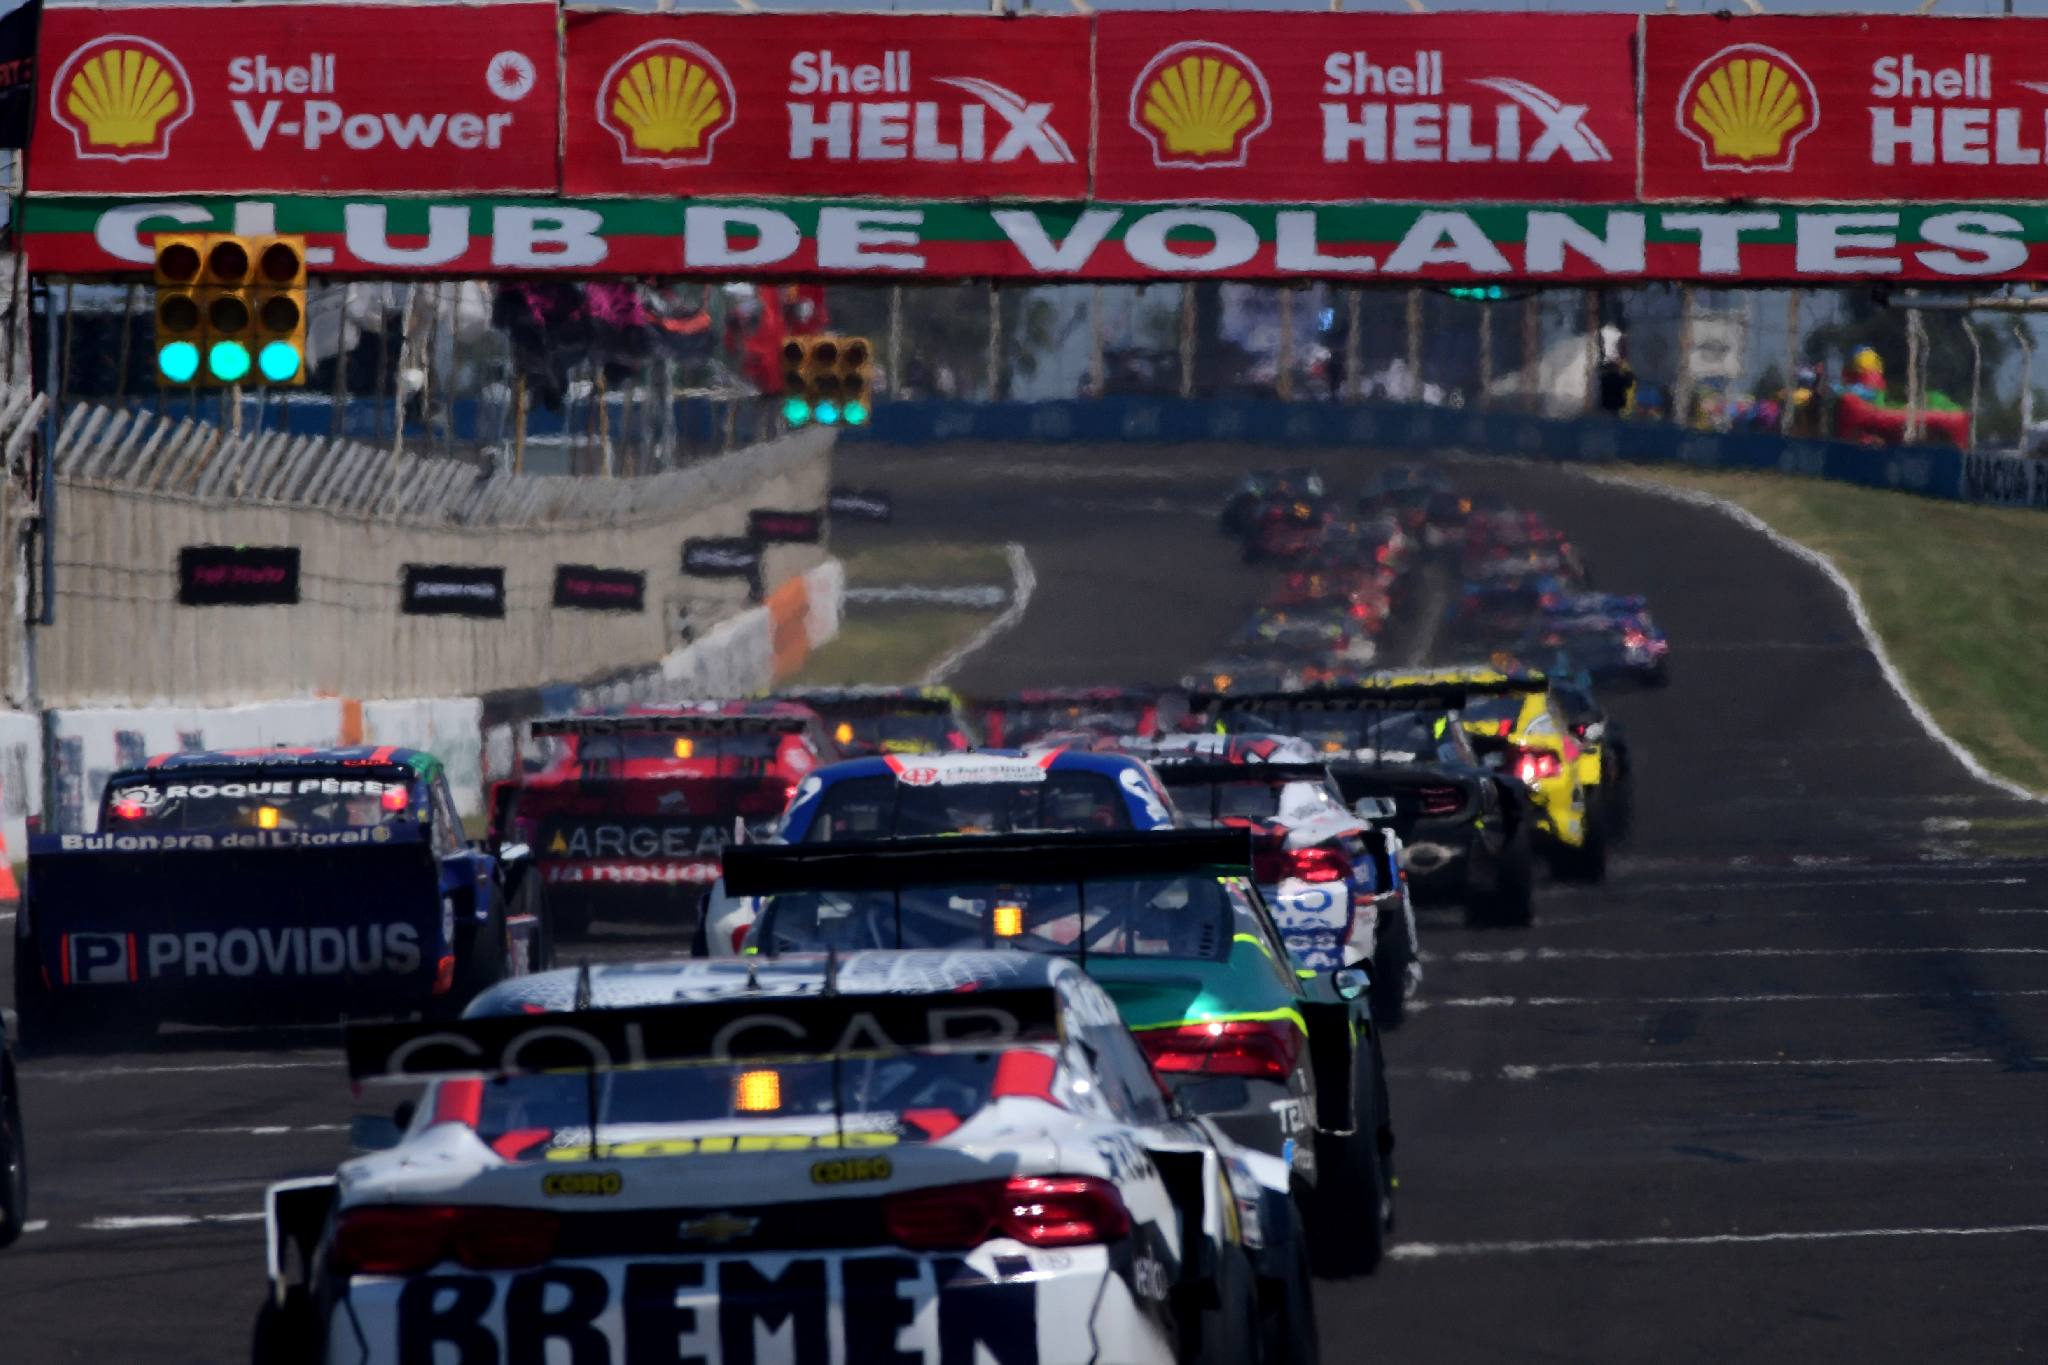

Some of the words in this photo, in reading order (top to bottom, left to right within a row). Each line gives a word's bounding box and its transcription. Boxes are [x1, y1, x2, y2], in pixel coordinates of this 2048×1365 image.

[229, 53, 335, 93] Shell
[789, 50, 911, 94] Shell
[1323, 51, 1444, 95] Shell
[1872, 53, 1992, 98] Shell
[232, 100, 513, 150] V-Power
[786, 99, 1075, 163] HELIX
[1320, 99, 1613, 163] HELIX
[1868, 106, 2048, 165] HEL
[684, 207, 925, 270] DE
[991, 208, 2029, 275] VOLANTES
[165, 781, 293, 800] ROQUE
[220, 830, 266, 847] del
[271, 827, 369, 847] Litoral
[148, 924, 422, 978] PROVIDUS
[398, 1256, 1038, 1365] BREMEN
